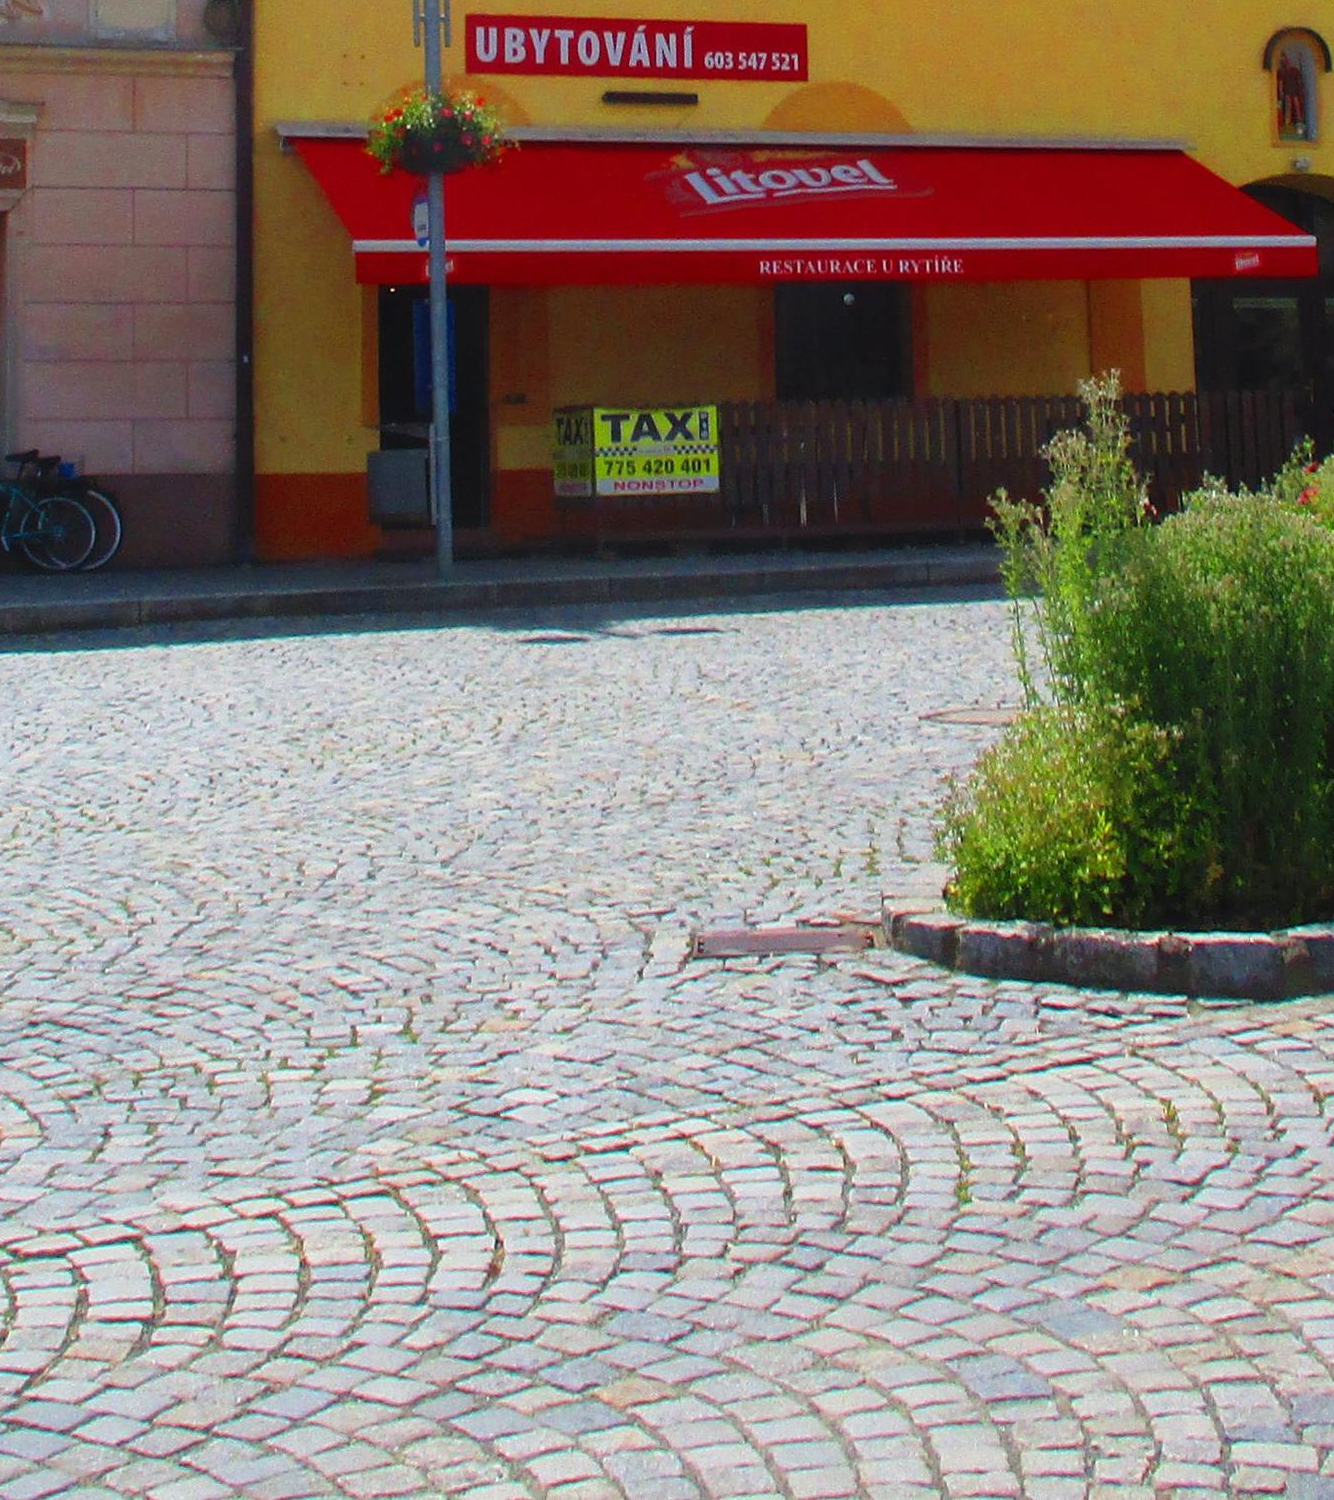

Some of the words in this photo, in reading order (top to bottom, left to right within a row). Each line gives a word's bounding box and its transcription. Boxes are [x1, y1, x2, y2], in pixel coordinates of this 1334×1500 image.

[475, 25, 694, 69] UBYTOVÁNÍ
[704, 51, 734, 70] 603
[737, 51, 767, 71] 547
[771, 52, 800, 72] 521
[684, 158, 897, 206] Litovel
[759, 258, 877, 275] RESTAURACE
[882, 258, 894, 274] U
[899, 254, 964, 274] RYTÍŘE
[601, 411, 710, 443] TAXI
[604, 459, 636, 476] 775
[643, 459, 674, 475] 420
[681, 458, 711, 473] 401
[613, 478, 704, 491] NONSTOP
